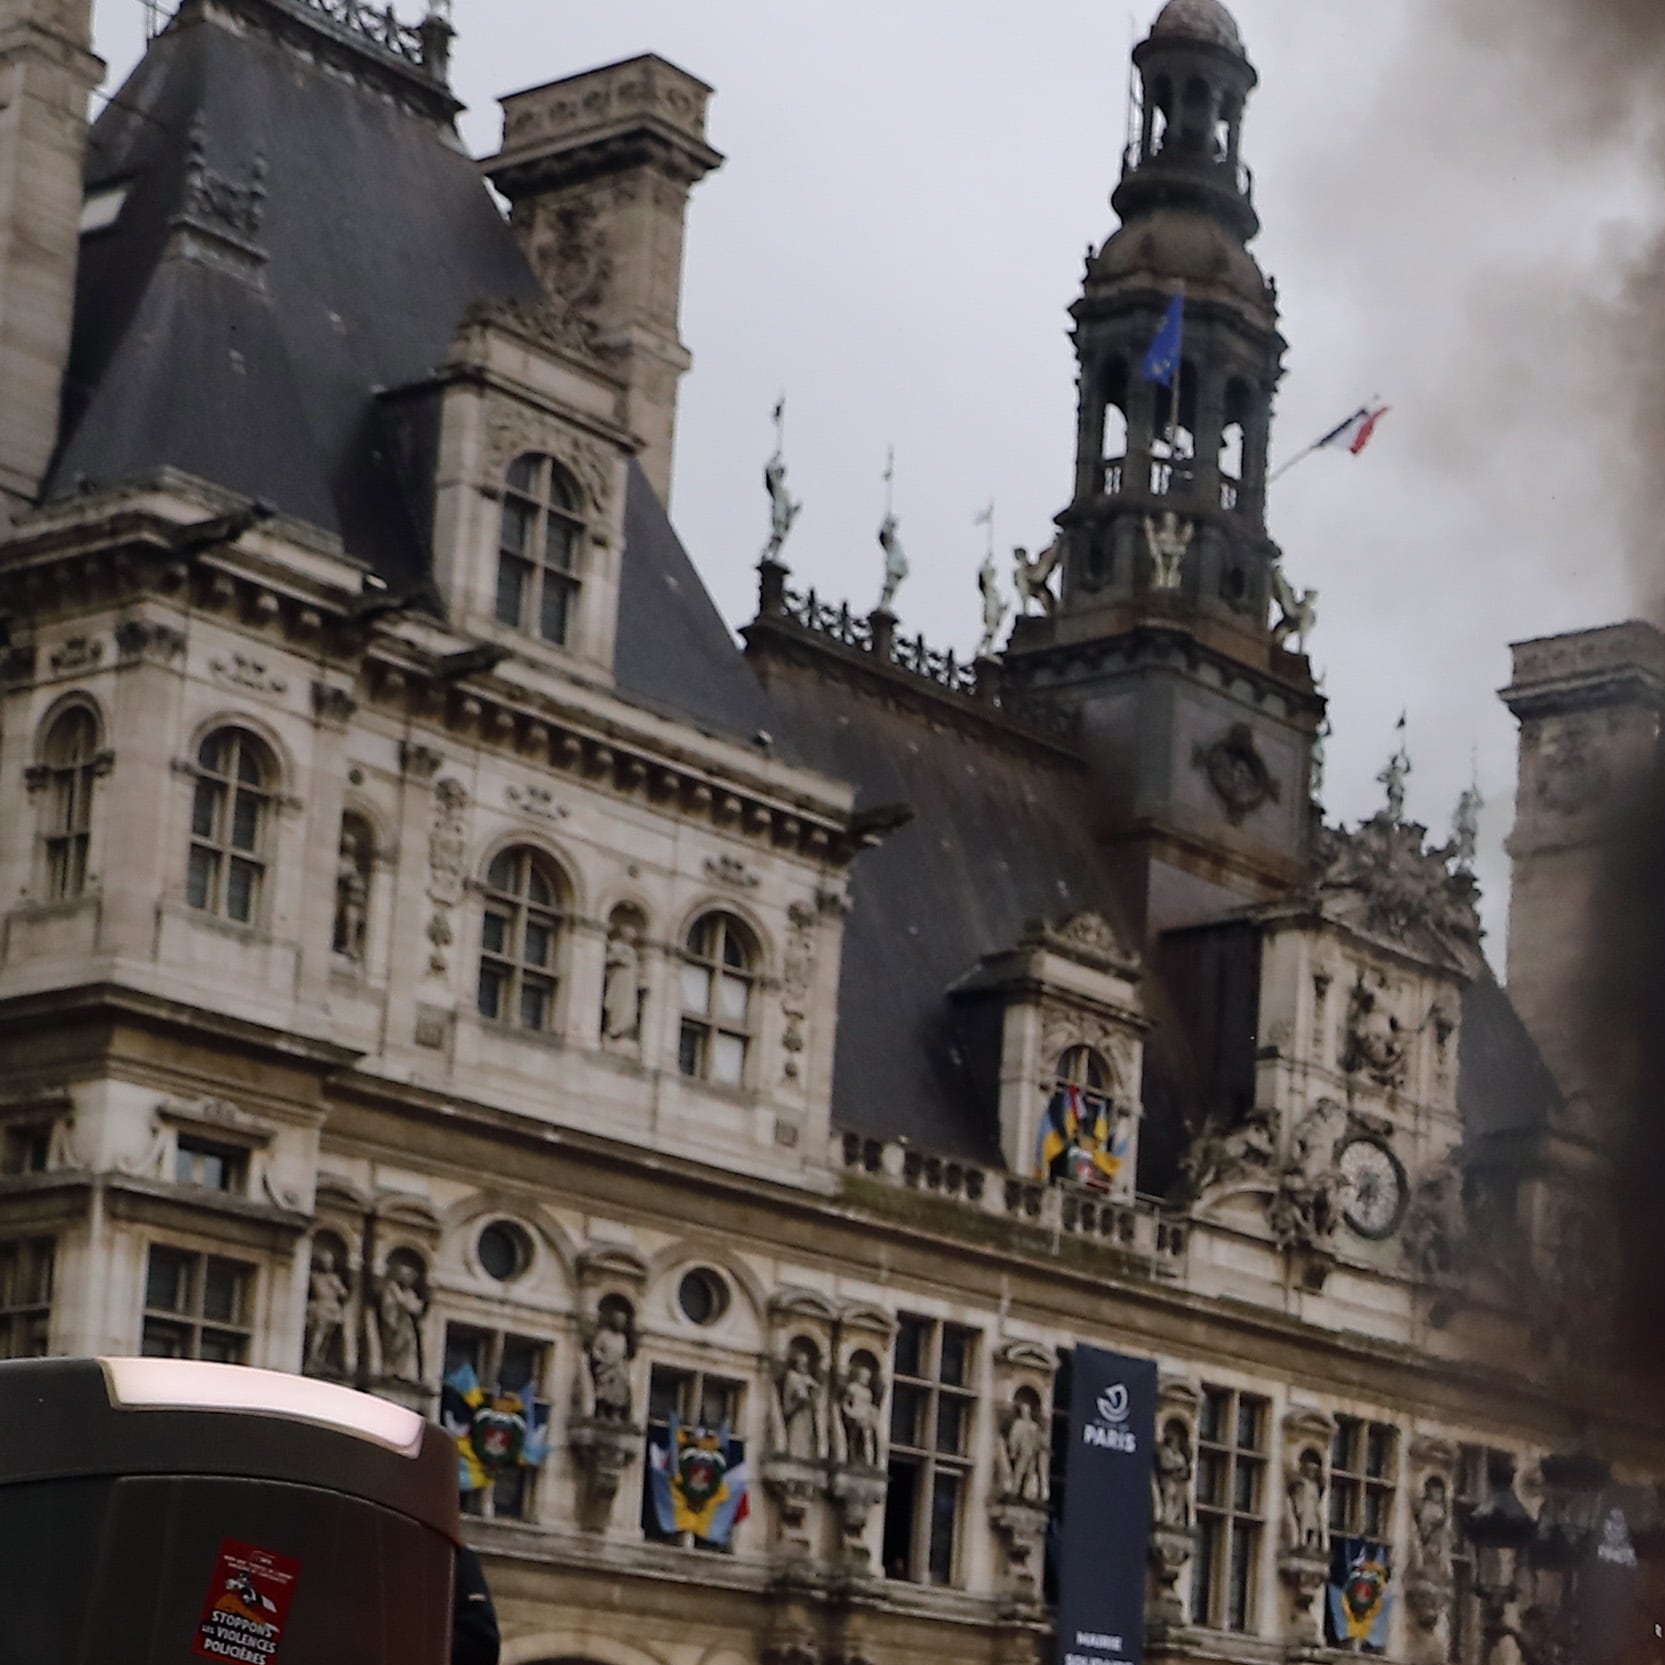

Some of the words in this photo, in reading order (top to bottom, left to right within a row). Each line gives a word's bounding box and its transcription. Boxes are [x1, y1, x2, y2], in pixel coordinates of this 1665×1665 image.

[1083, 1424, 1137, 1454] PARIS
[211, 1609, 274, 1639] STOPPONS
[203, 1637, 268, 1665] POLICIÈRES
[216, 1626, 278, 1654] VIOLENCES
